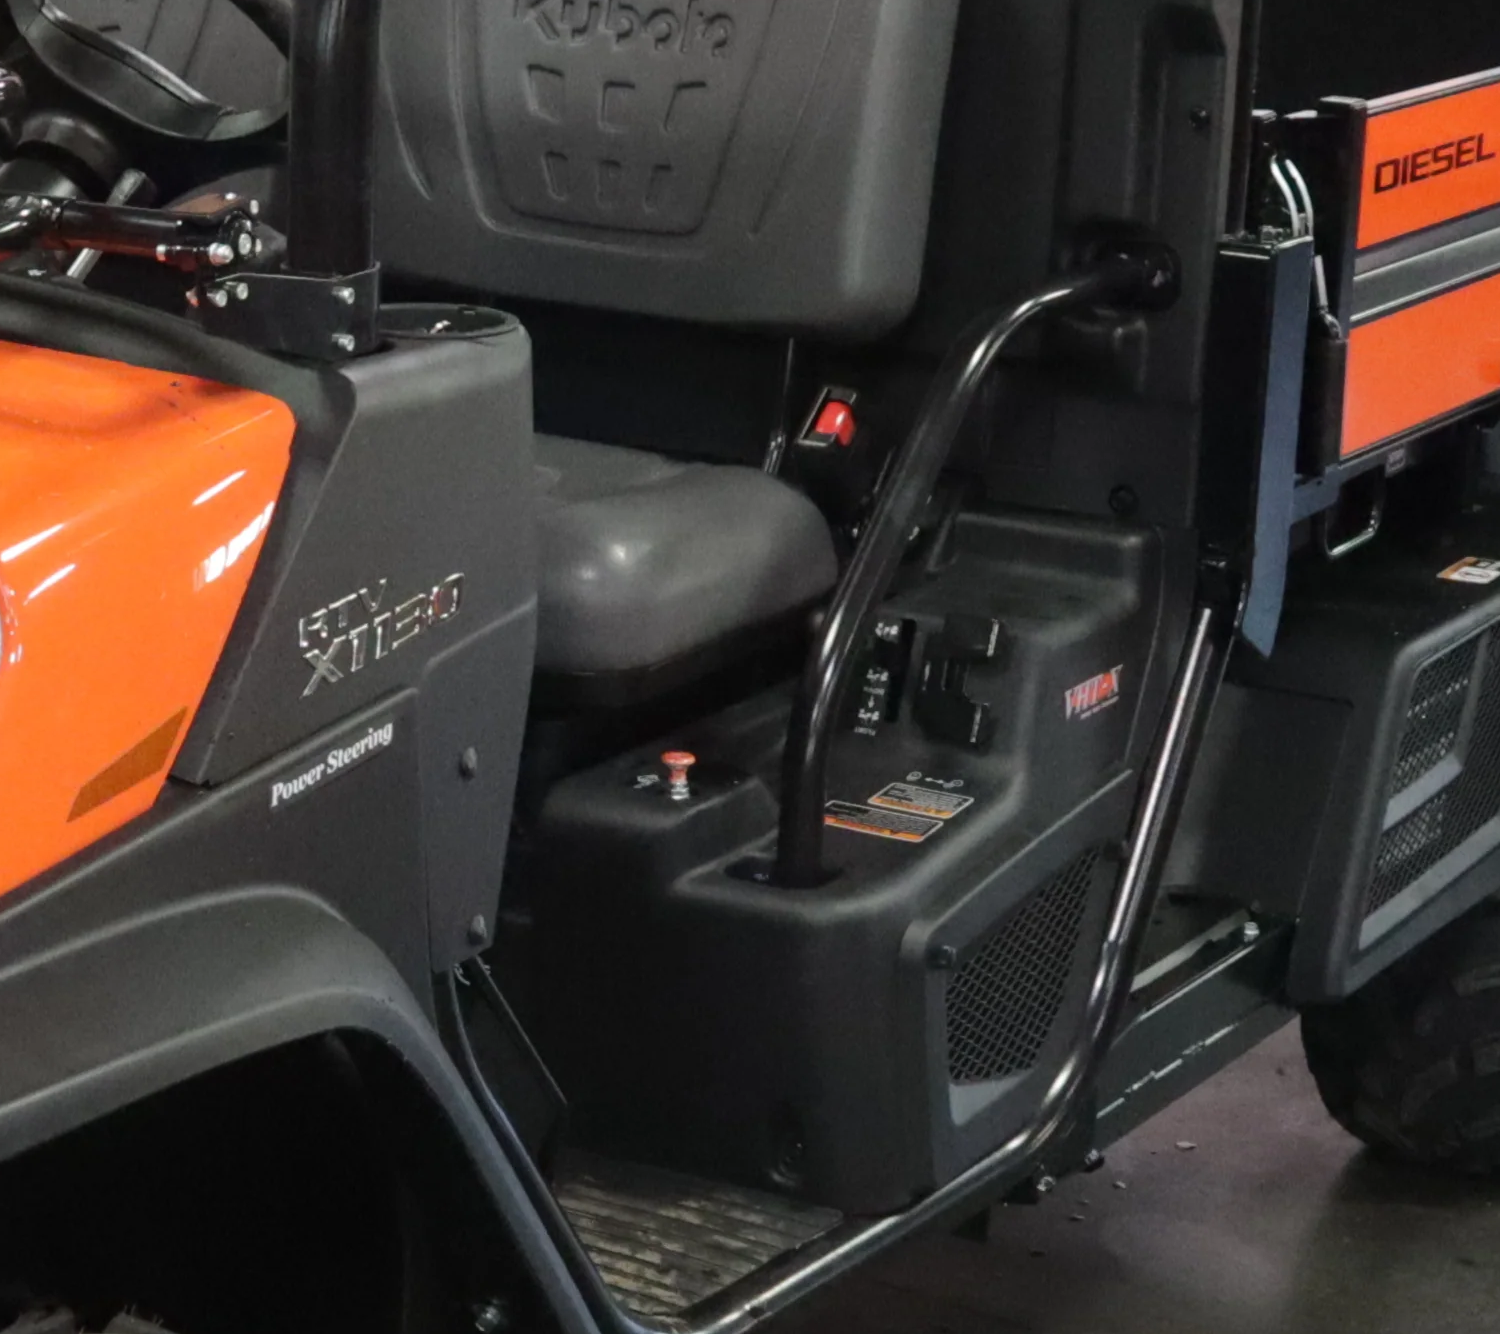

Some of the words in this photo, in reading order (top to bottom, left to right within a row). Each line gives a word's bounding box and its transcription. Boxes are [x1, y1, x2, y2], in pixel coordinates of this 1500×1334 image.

[1373, 133, 1496, 194] DIESEL
[269, 762, 326, 808] Power
[325, 720, 394, 775] Steering
